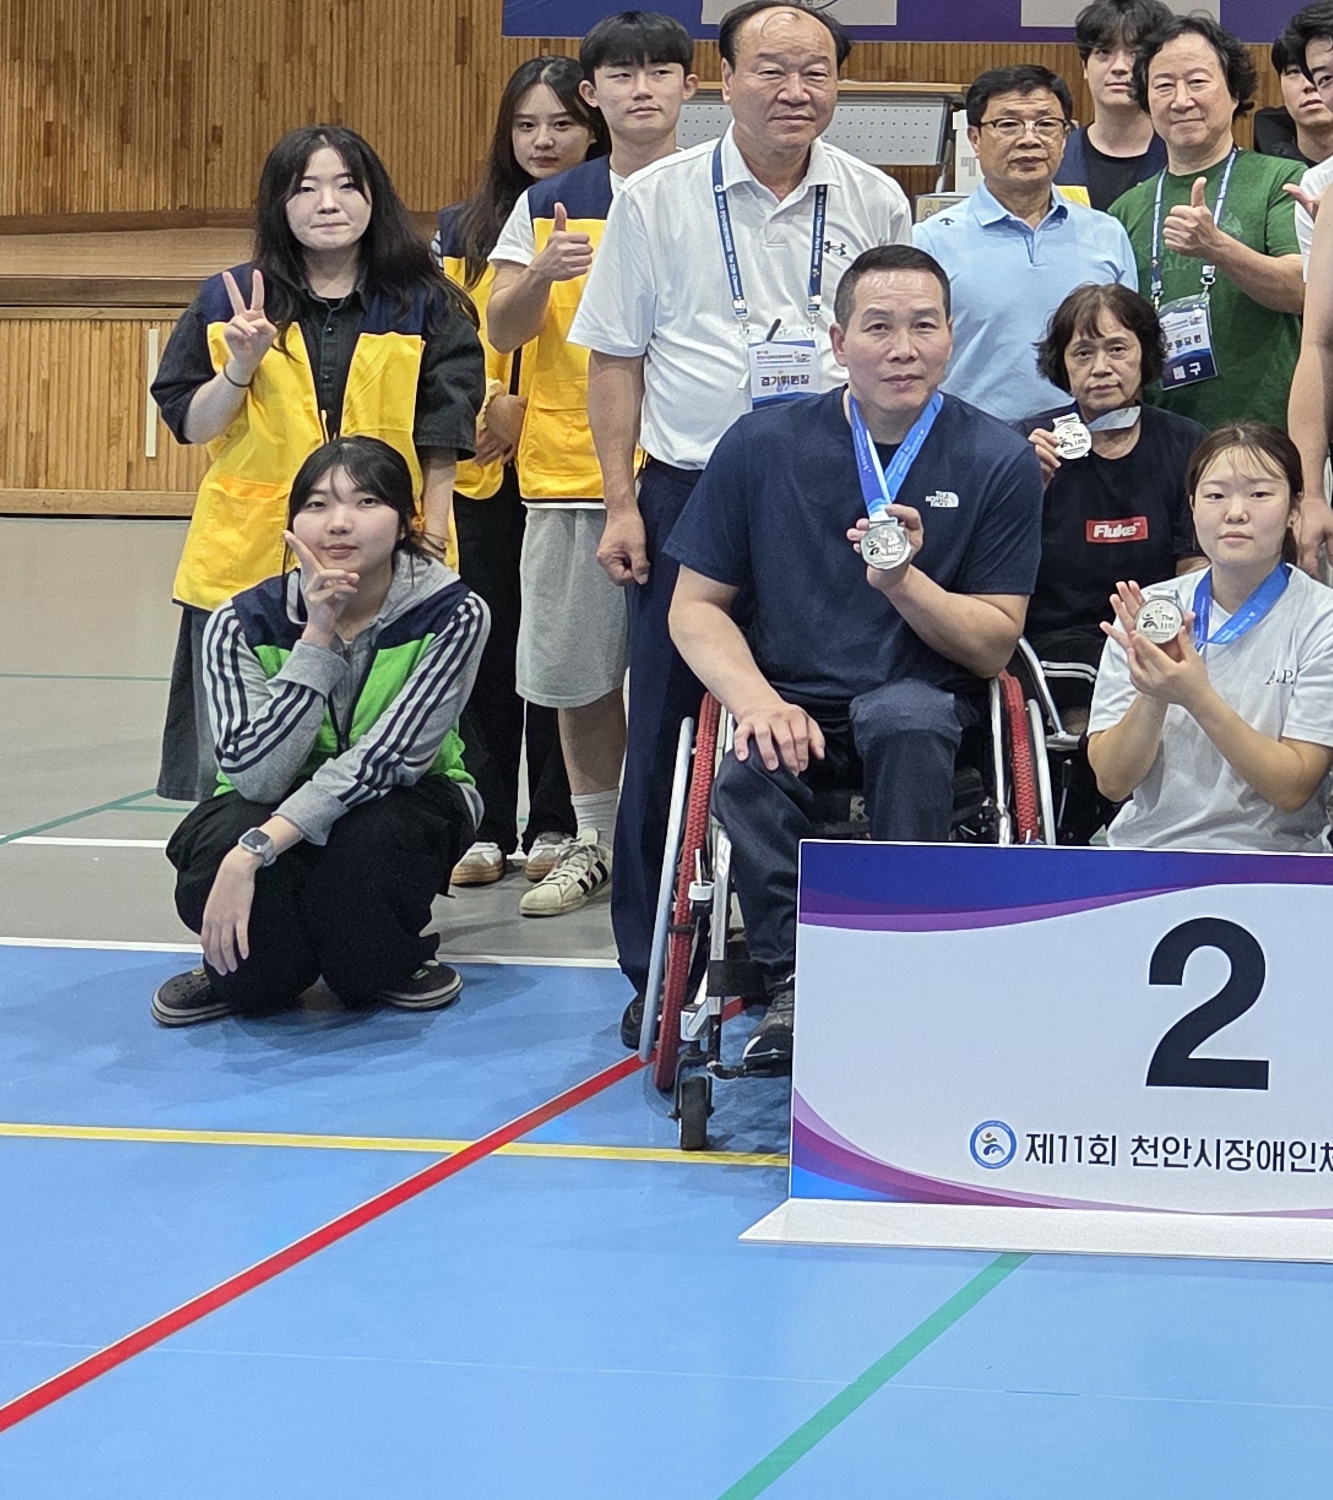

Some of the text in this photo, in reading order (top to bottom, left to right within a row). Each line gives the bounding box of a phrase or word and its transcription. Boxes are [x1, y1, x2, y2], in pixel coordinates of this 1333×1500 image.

[1093, 523, 1137, 538] Fluke
[1145, 916, 1270, 1091] 2
[1024, 1132, 1118, 1167] 제11회
